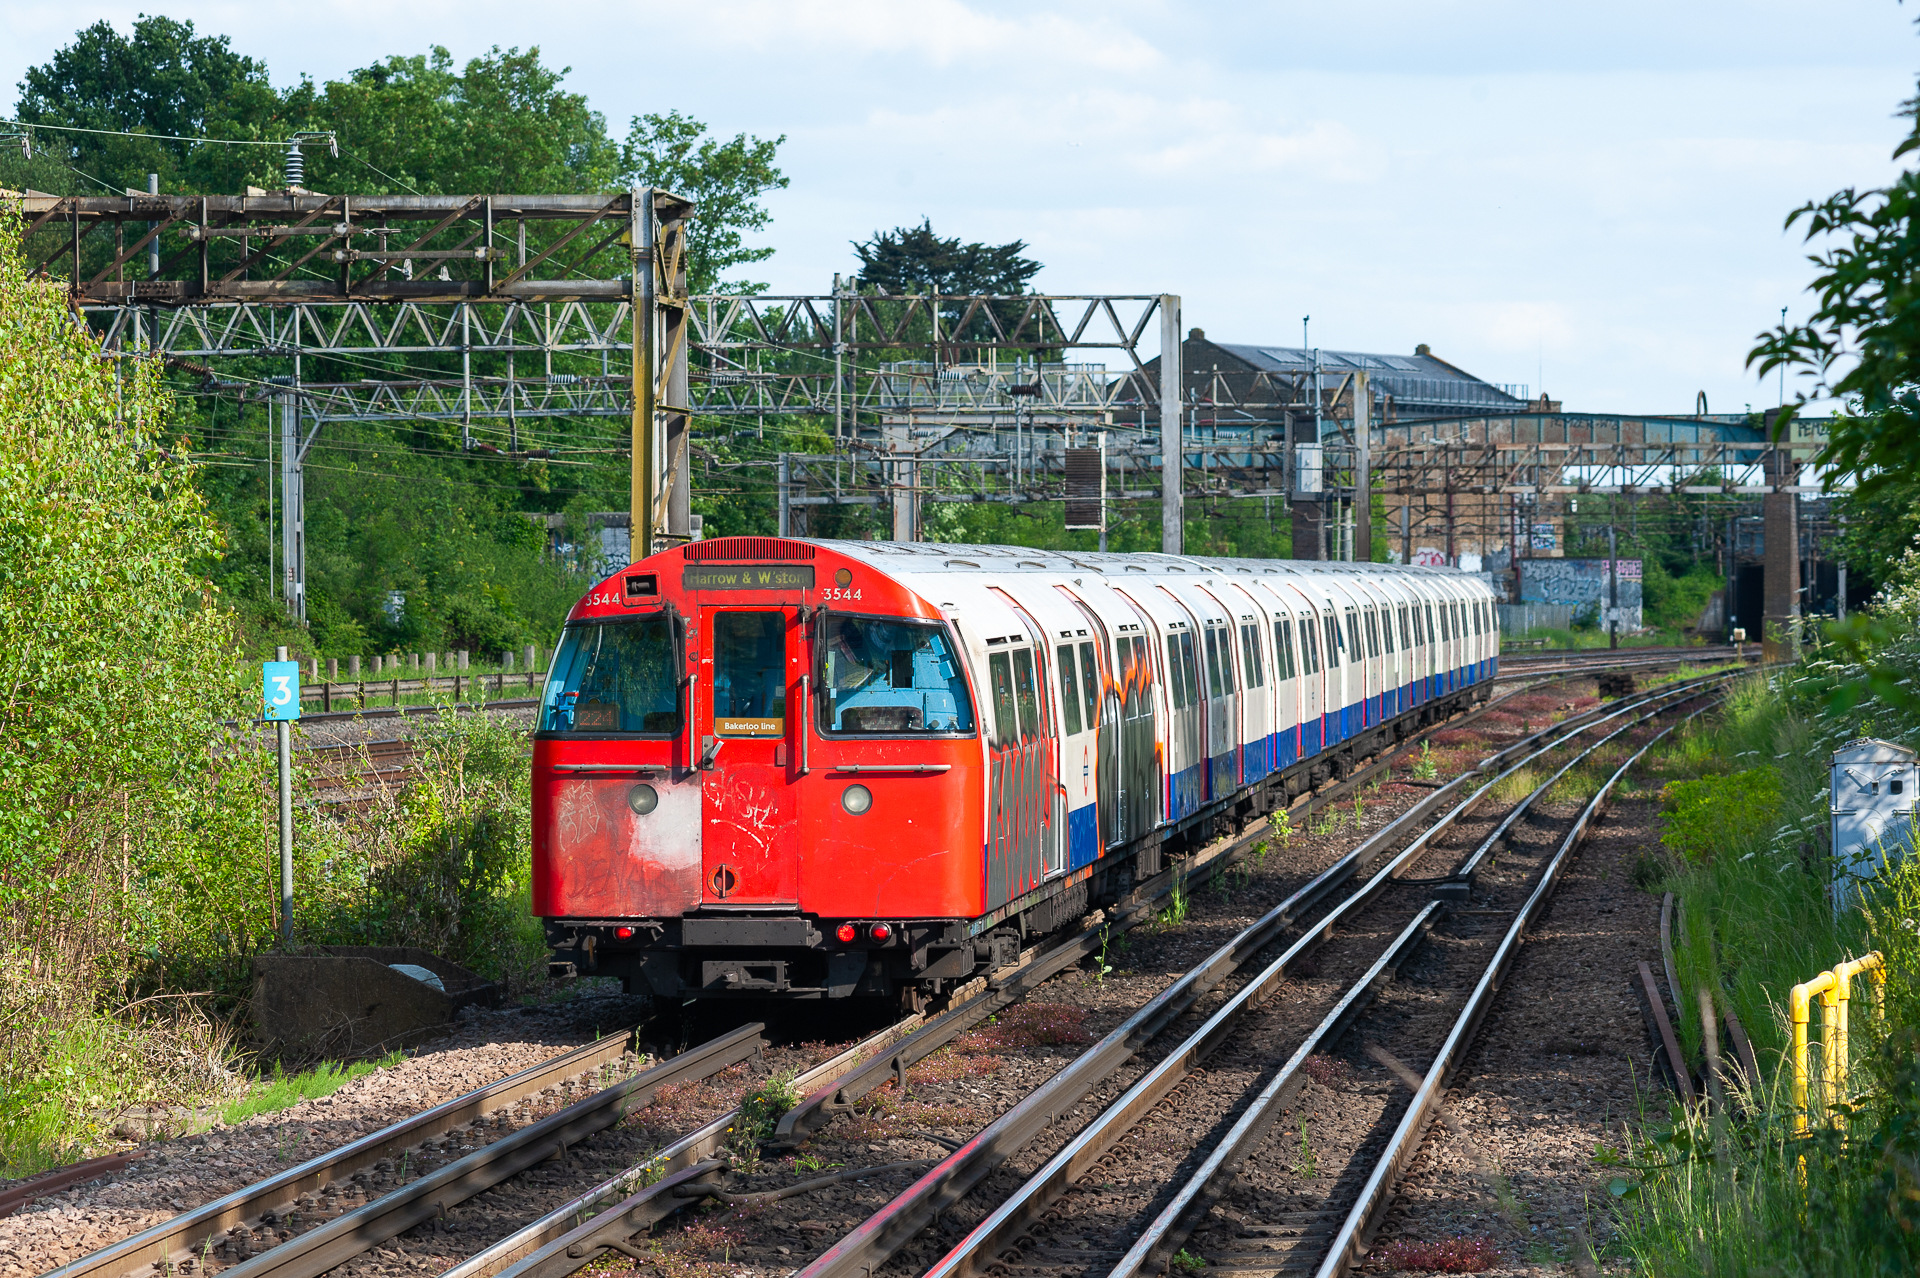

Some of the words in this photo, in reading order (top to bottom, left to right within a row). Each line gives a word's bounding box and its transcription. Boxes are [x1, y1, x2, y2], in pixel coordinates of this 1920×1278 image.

[690, 572, 737, 585] Harrow
[742, 571, 752, 584] &
[585, 592, 621, 607] 3544
[823, 588, 862, 601] 3544
[271, 675, 292, 706] 3
[579, 710, 613, 726] 224
[724, 722, 759, 730] Bakerloo
[761, 722, 776, 730] line
